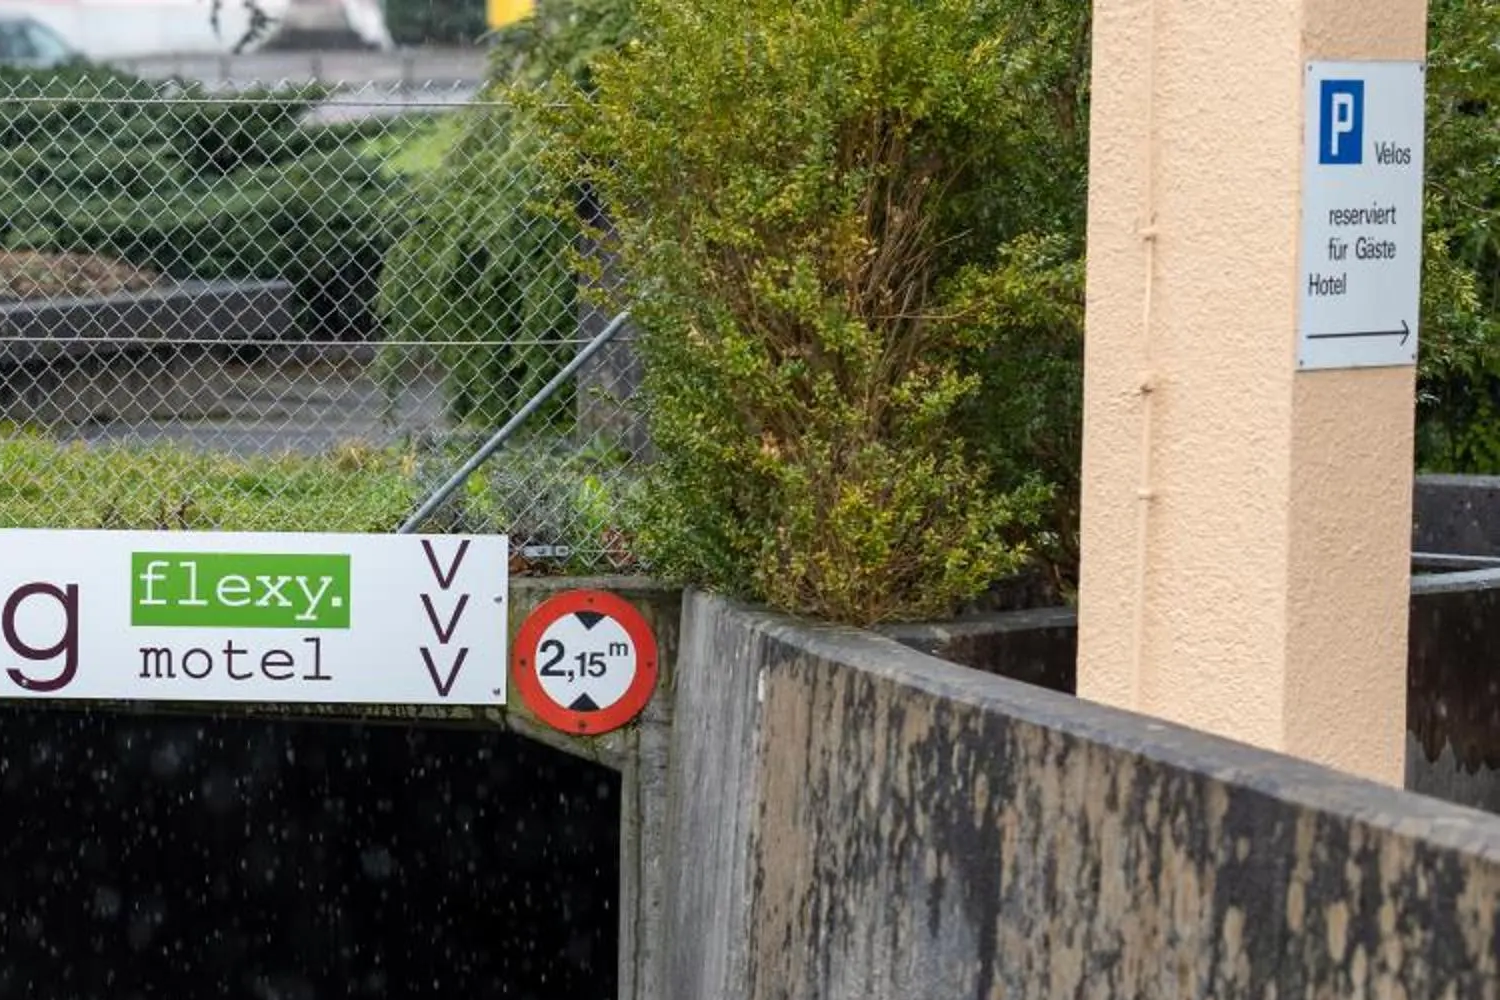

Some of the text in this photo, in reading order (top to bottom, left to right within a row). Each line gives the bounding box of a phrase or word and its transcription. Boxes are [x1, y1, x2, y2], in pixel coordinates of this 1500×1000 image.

[1331, 92, 1354, 156] P
[1374, 141, 1411, 165] Velos
[1328, 201, 1397, 226] reserviert
[1328, 236, 1397, 261] für Gäste
[1308, 272, 1347, 297] Hotel
[139, 637, 332, 680] motel
